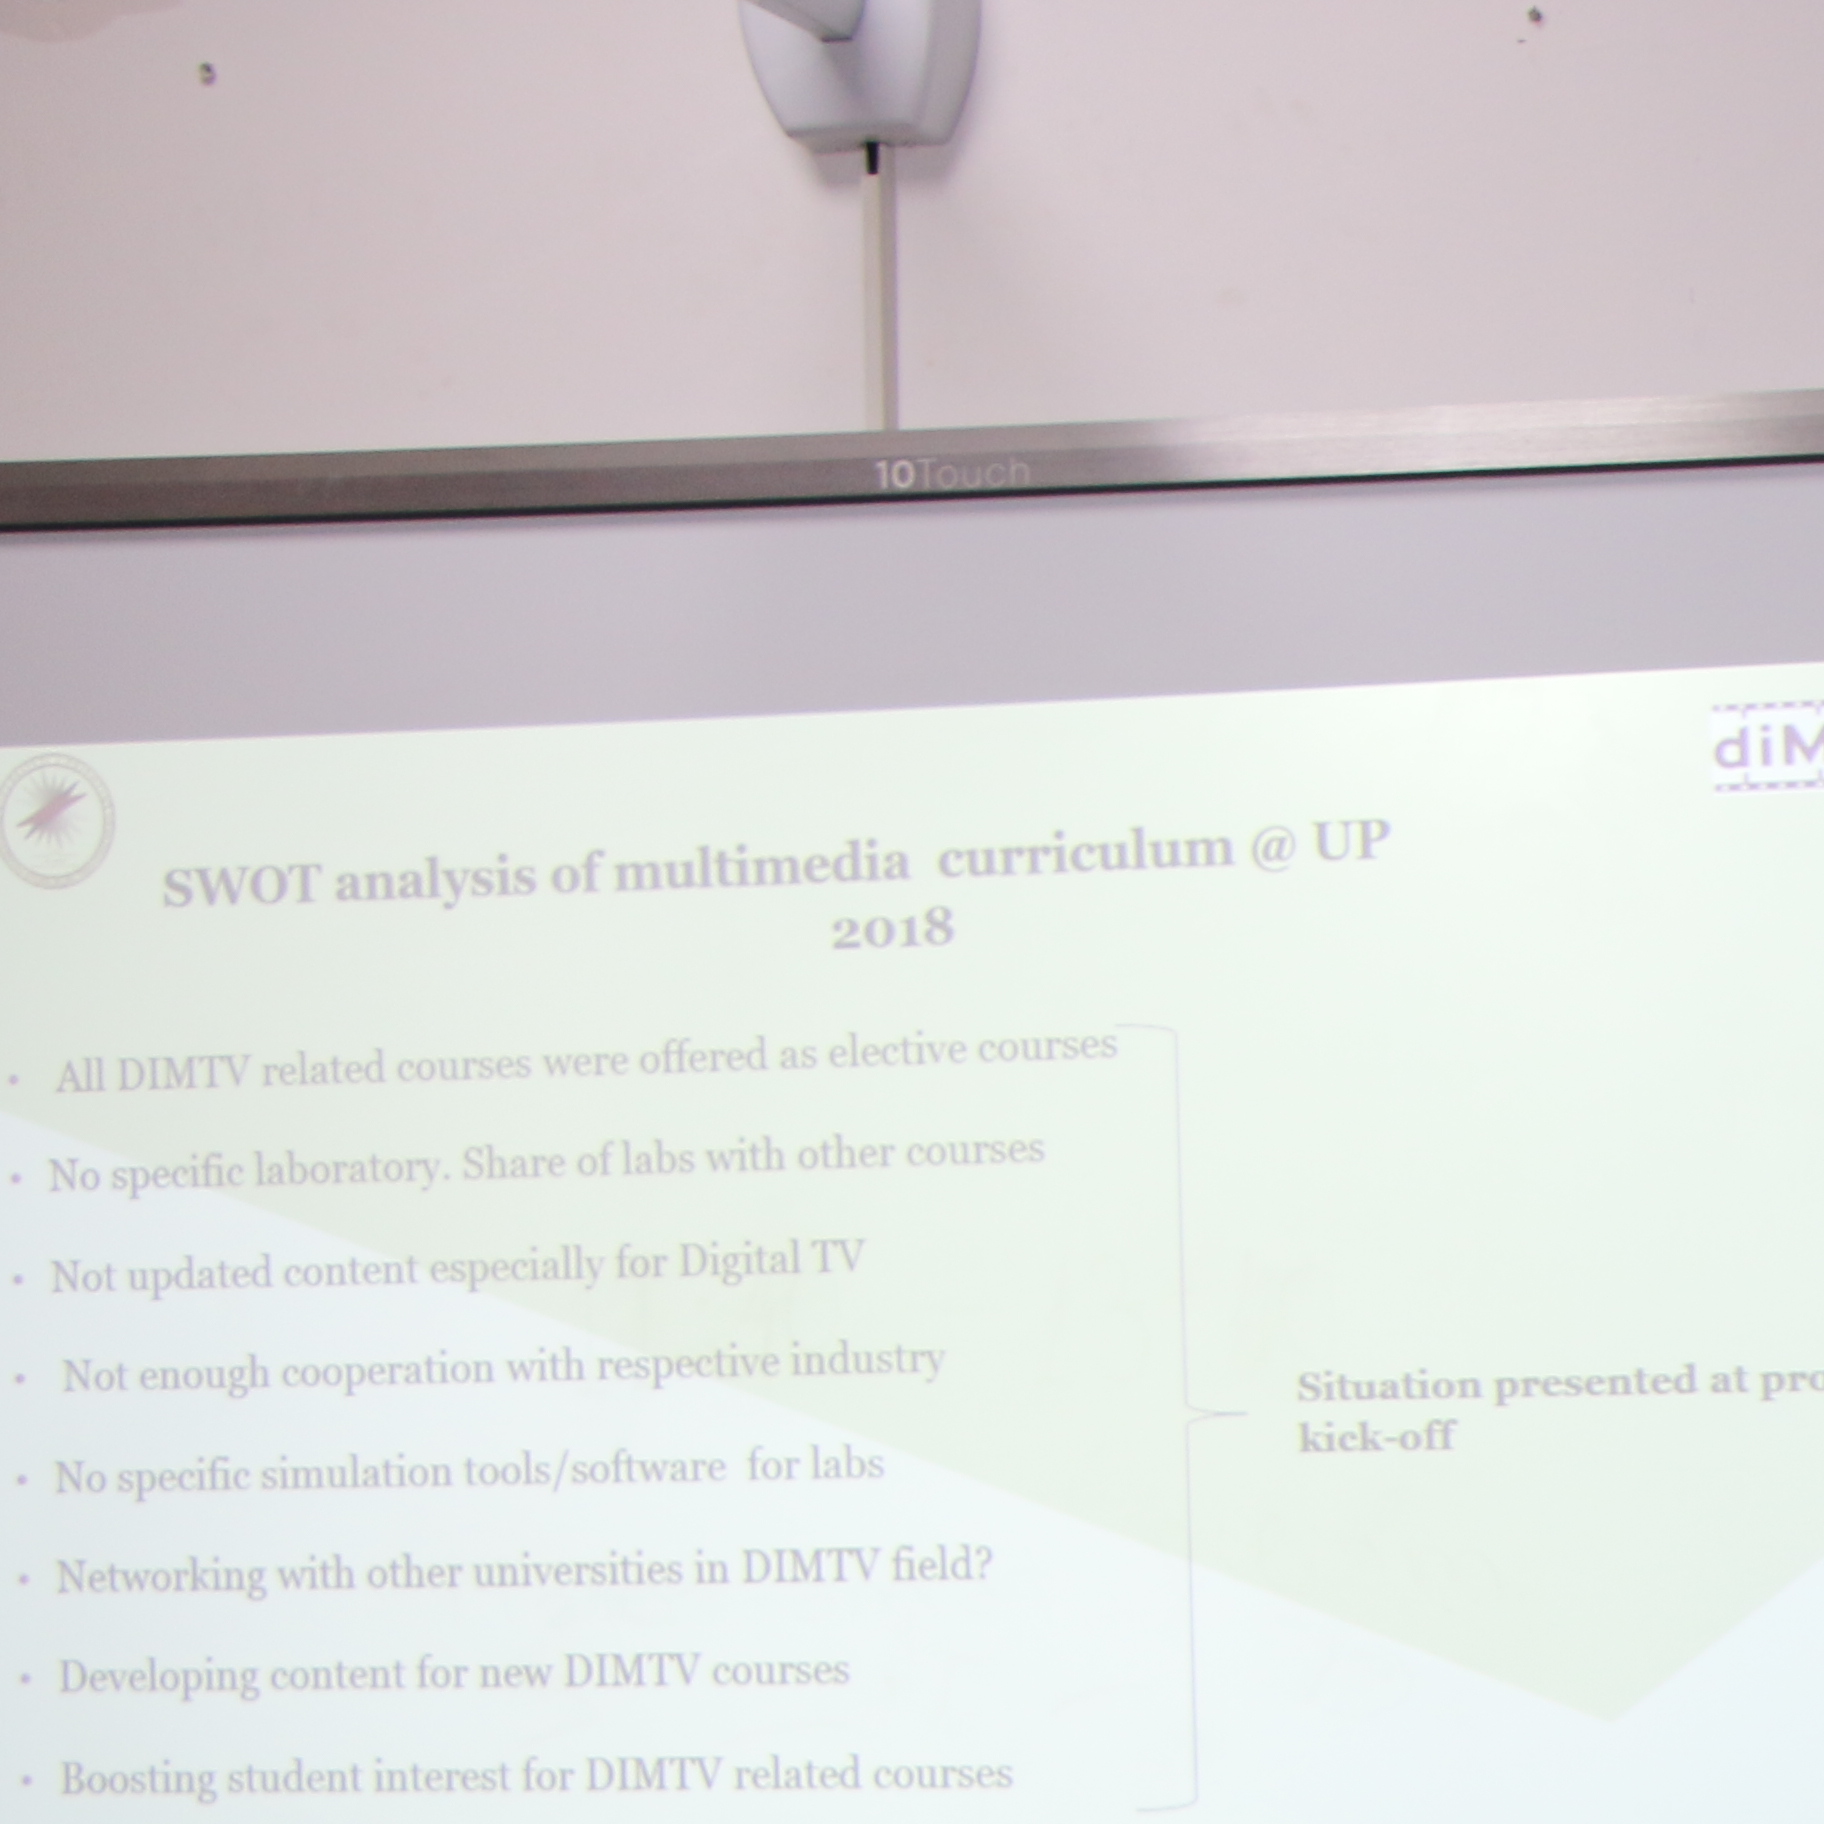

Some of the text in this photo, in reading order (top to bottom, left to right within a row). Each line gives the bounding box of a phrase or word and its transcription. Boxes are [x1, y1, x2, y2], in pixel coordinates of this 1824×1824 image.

[163, 863, 323, 908] SWOT
[335, 853, 538, 911] analysis
[551, 849, 606, 894] of
[614, 838, 911, 892] multimedia
[938, 826, 1235, 879] curriculum
[1314, 819, 1392, 862] UP
[832, 906, 956, 950] 2018
[55, 1029, 1119, 1094] All DIMTV related courses were offered as elective courses
[48, 1132, 1046, 1201] No specific laboratory. Share of labs with other courses
[51, 1237, 867, 1302] Not updated content especially for Digital TV
[63, 1338, 946, 1401] Not enough cooperation with respective industry
[1297, 1368, 1484, 1402] Situation
[1494, 1362, 1699, 1408] presented
[1709, 1365, 1750, 1395] at
[1299, 1418, 1459, 1454] kick-off
[55, 1443, 886, 1505] No specific simulation tools/software for labs
[56, 1543, 994, 1603] Networking with other universities in DIMTV field?
[60, 1652, 852, 1704] Developing content for new DIMTV courses
[61, 1753, 1014, 1806] Boosting student interest for DIMTV related courses
